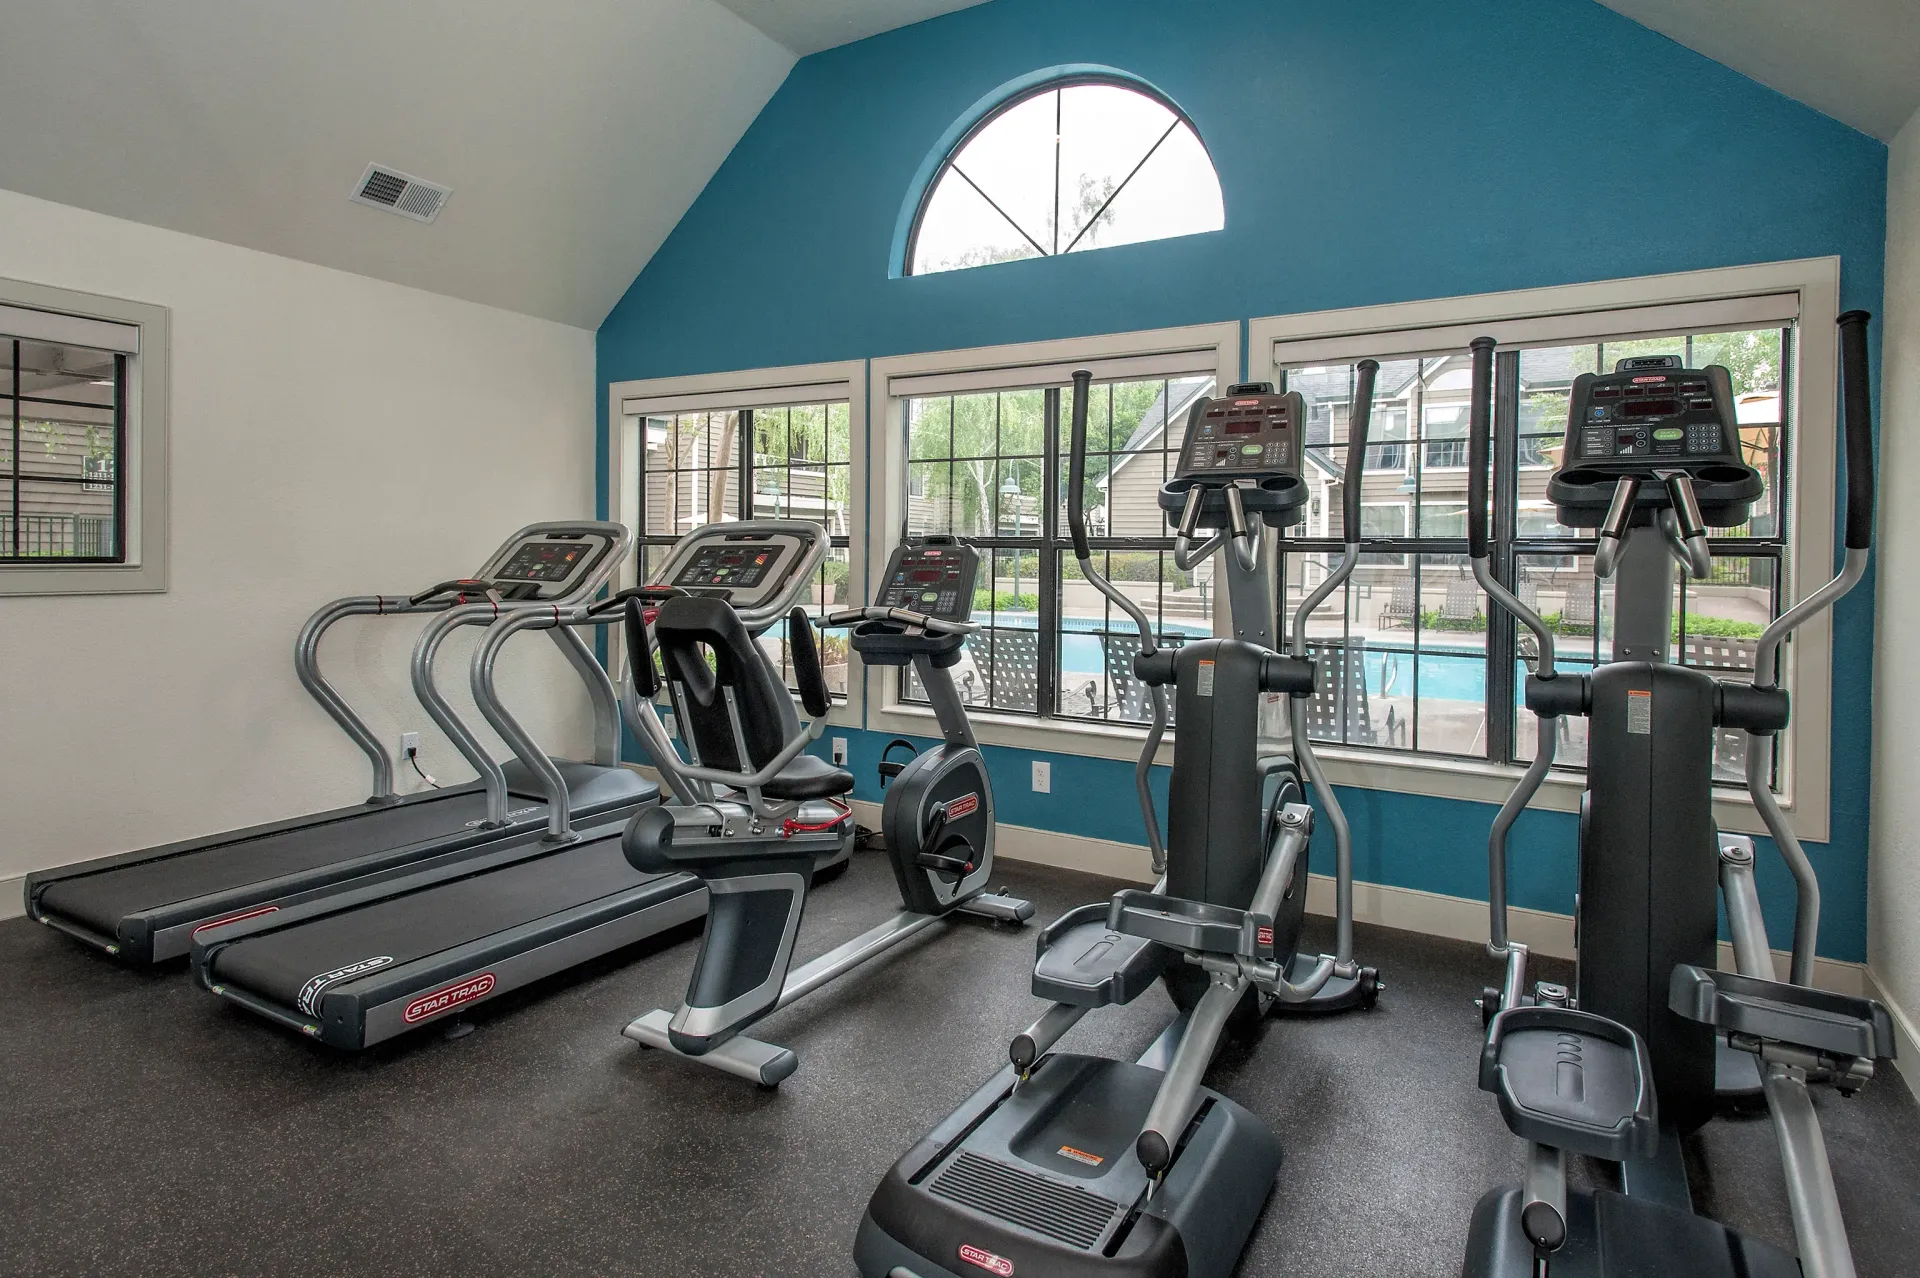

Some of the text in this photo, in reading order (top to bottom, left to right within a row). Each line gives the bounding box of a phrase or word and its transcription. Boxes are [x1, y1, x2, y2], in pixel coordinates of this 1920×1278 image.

[328, 958, 384, 979] STAR
[412, 980, 488, 1014] STAR TRAC
[962, 1248, 1008, 1270] STAR TRAC
